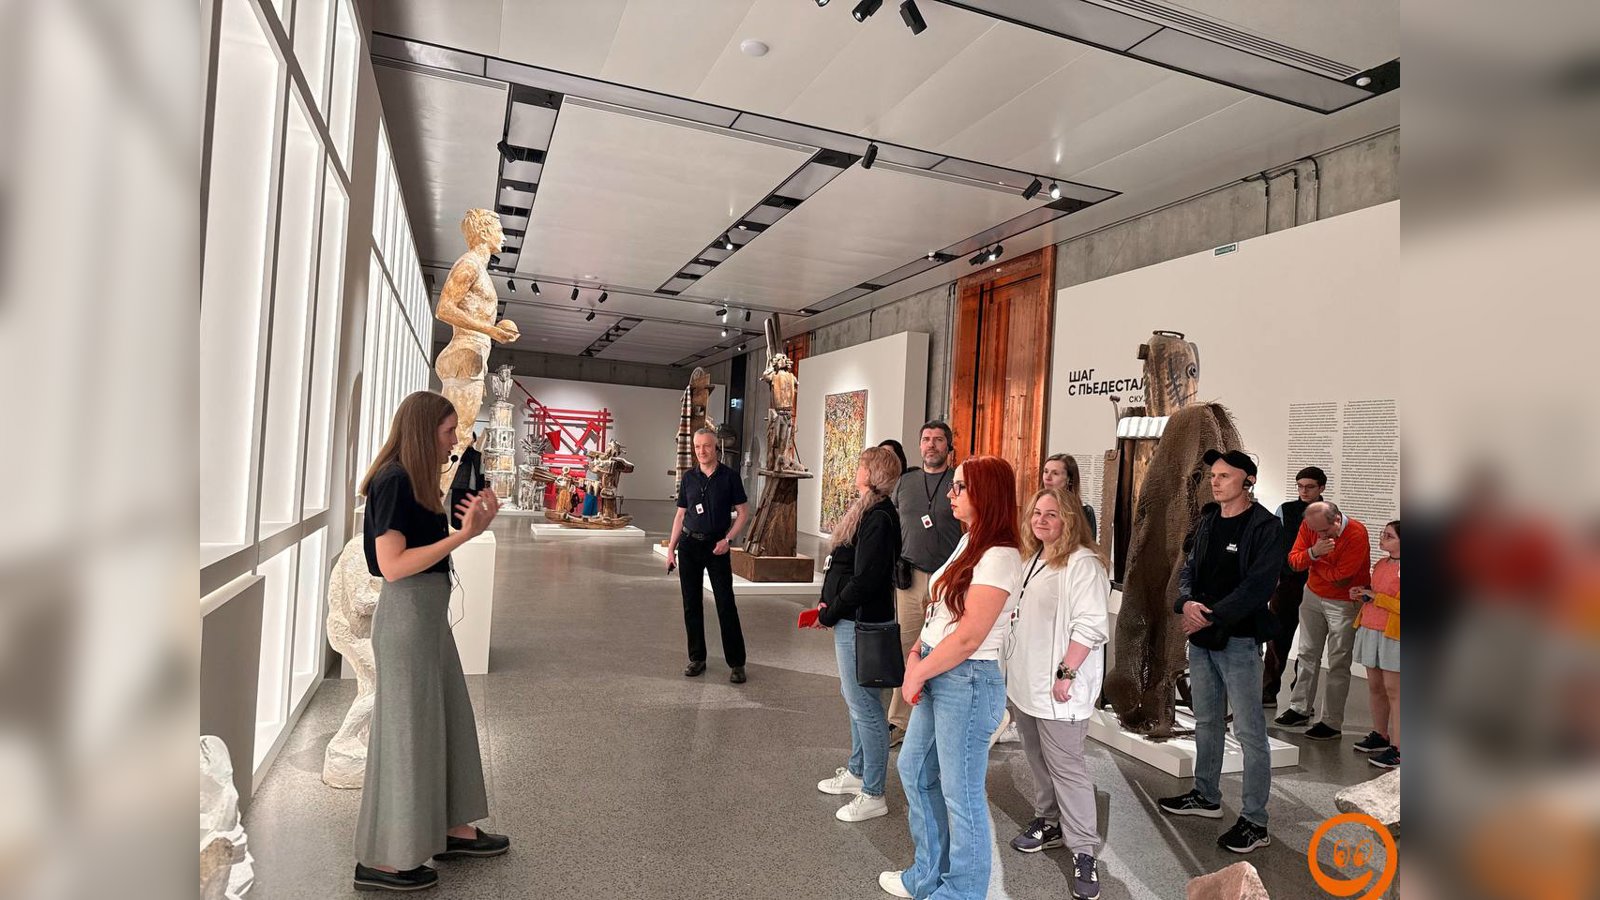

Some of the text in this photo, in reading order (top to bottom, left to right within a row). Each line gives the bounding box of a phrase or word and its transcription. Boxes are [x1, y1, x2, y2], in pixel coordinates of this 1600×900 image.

[1069, 369, 1095, 382] ШАГ
[1068, 384, 1076, 396] С
[1128, 395, 1145, 403] СКУ
